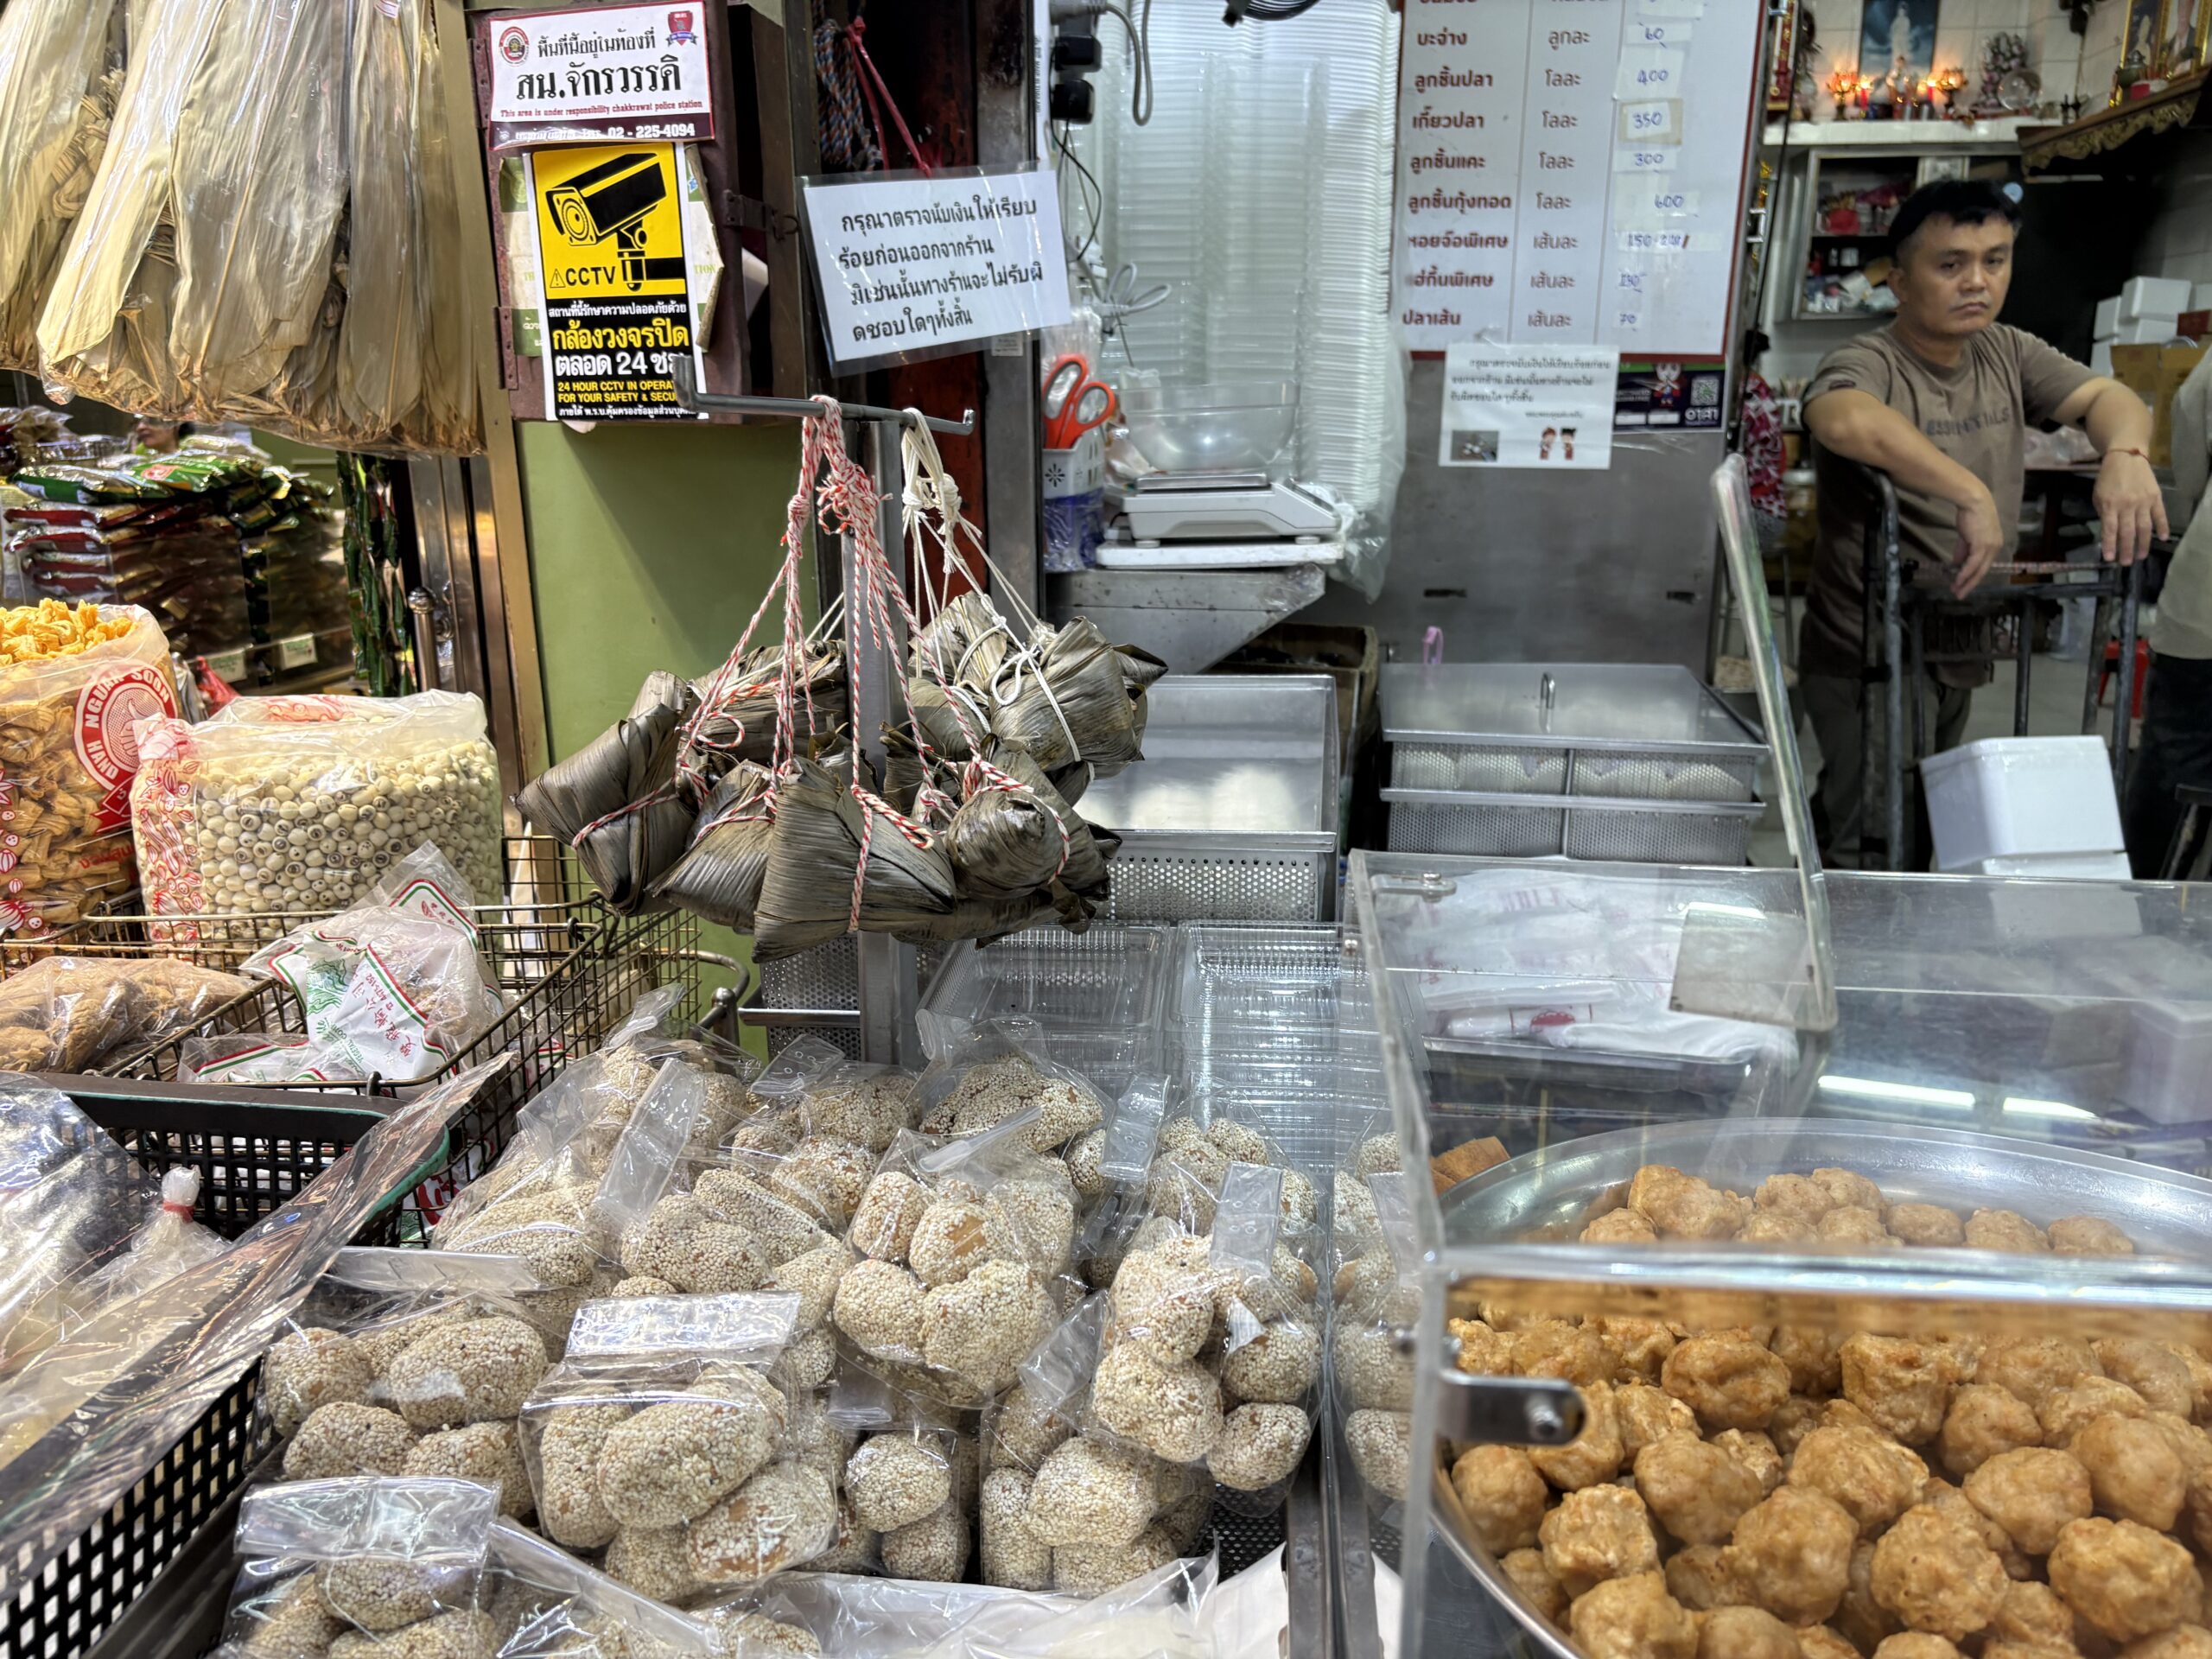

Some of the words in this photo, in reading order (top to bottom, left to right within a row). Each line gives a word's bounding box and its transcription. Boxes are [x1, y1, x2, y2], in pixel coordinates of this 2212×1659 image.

[1417, 27, 1467, 46] บะจ่าง
[1548, 29, 1590, 50] ลูกละ
[1414, 66, 1493, 93] ลูกชิ้นปลา
[1545, 69, 1581, 87] โลละ
[1637, 69, 1669, 86] 400
[566, 105, 610, 117] responsibility
[655, 101, 676, 111] police
[678, 100, 702, 109] station
[1542, 111, 1578, 130] โลละ
[607, 127, 625, 138] 02
[635, 124, 695, 138] 225-4094
[1410, 147, 1485, 175] ลูกชิ้นแคะ
[1539, 151, 1574, 170] โลละ
[1634, 152, 1664, 167] 300
[1408, 188, 1511, 214] ลูกชิ้นกุ้งทอด
[1536, 192, 1572, 210] โลละ
[1654, 194, 1684, 208] 600
[1533, 231, 1578, 250] เส้นละ
[839, 235, 995, 270] ร้อยก่อนออกจากร้าน
[565, 266, 616, 286] CCTV
[1530, 270, 1575, 289] เส้นละ
[548, 299, 687, 317] สถานที่นี้รักษาความปลอดภัยด้วย
[1402, 308, 1460, 325] ปลาเส้น
[1528, 310, 1572, 328] เส้นละ
[553, 317, 690, 350] กล้องวงจรปิด
[556, 354, 612, 376] ตลอด
[616, 352, 648, 375] 24
[558, 382, 569, 391] 24
[573, 381, 599, 391] HOUR
[601, 381, 625, 391] CCTV
[626, 381, 638, 391] IN
[639, 380, 675, 391] OPERA
[558, 392, 576, 403] FOR
[578, 392, 602, 403] YOUR
[604, 392, 639, 402] SAFETY
[641, 392, 648, 402] &
[651, 391, 678, 402] SECU
[86, 676, 124, 728] NGUAN
[130, 667, 170, 704] SOON
[86, 740, 119, 780] HAND
